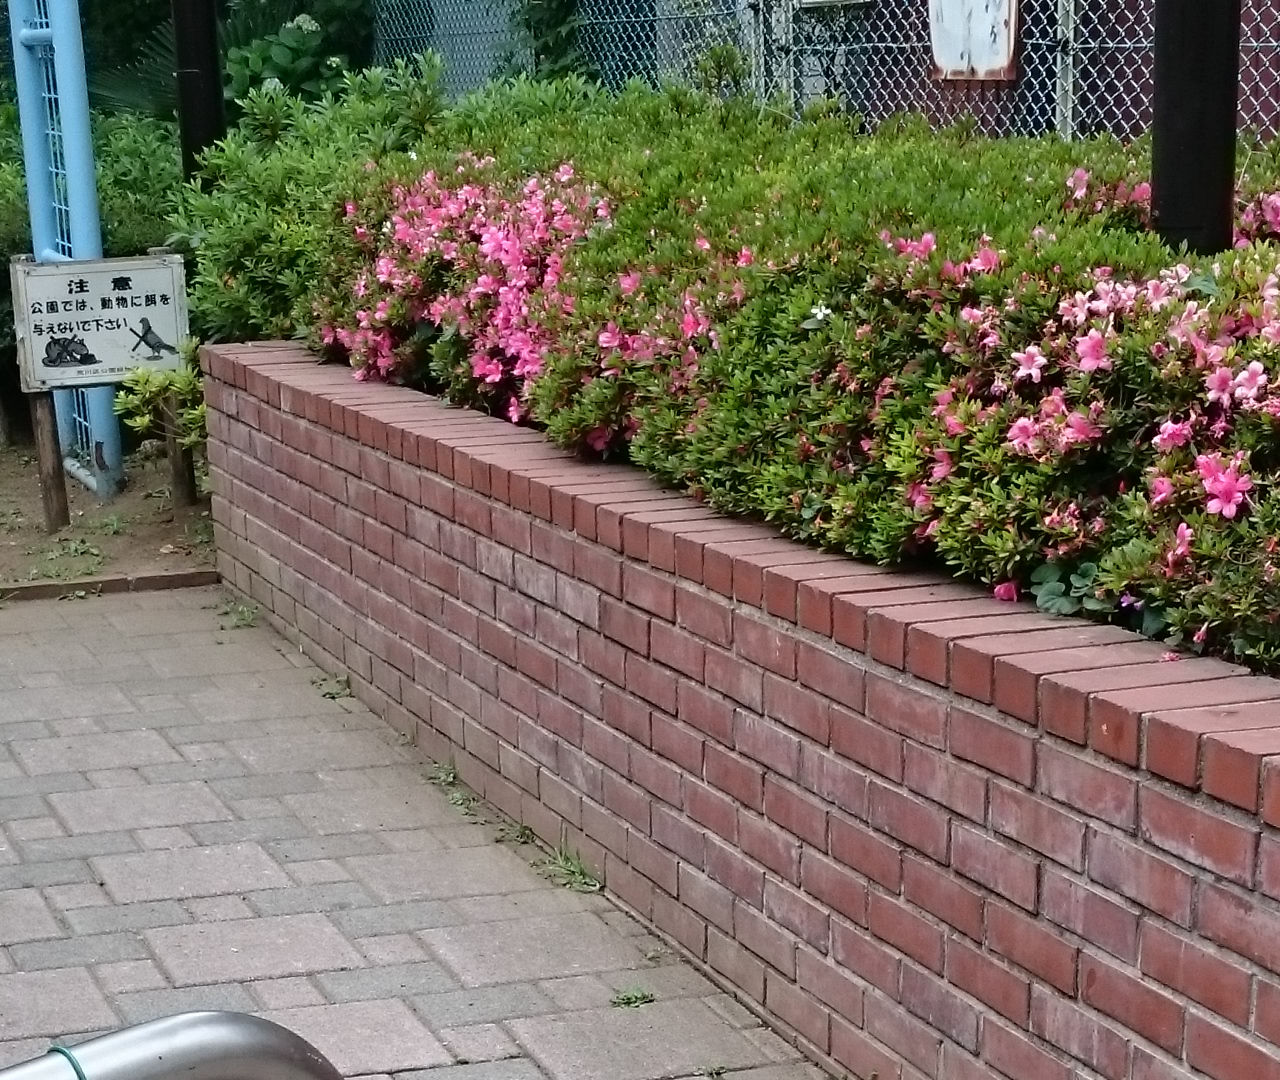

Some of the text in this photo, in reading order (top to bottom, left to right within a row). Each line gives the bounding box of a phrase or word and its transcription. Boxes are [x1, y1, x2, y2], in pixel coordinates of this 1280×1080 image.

[67, 277, 133, 294] 注意
[30, 293, 171, 314] 公園では、動物に餌を
[32, 318, 128, 336] 与えないで下さい
